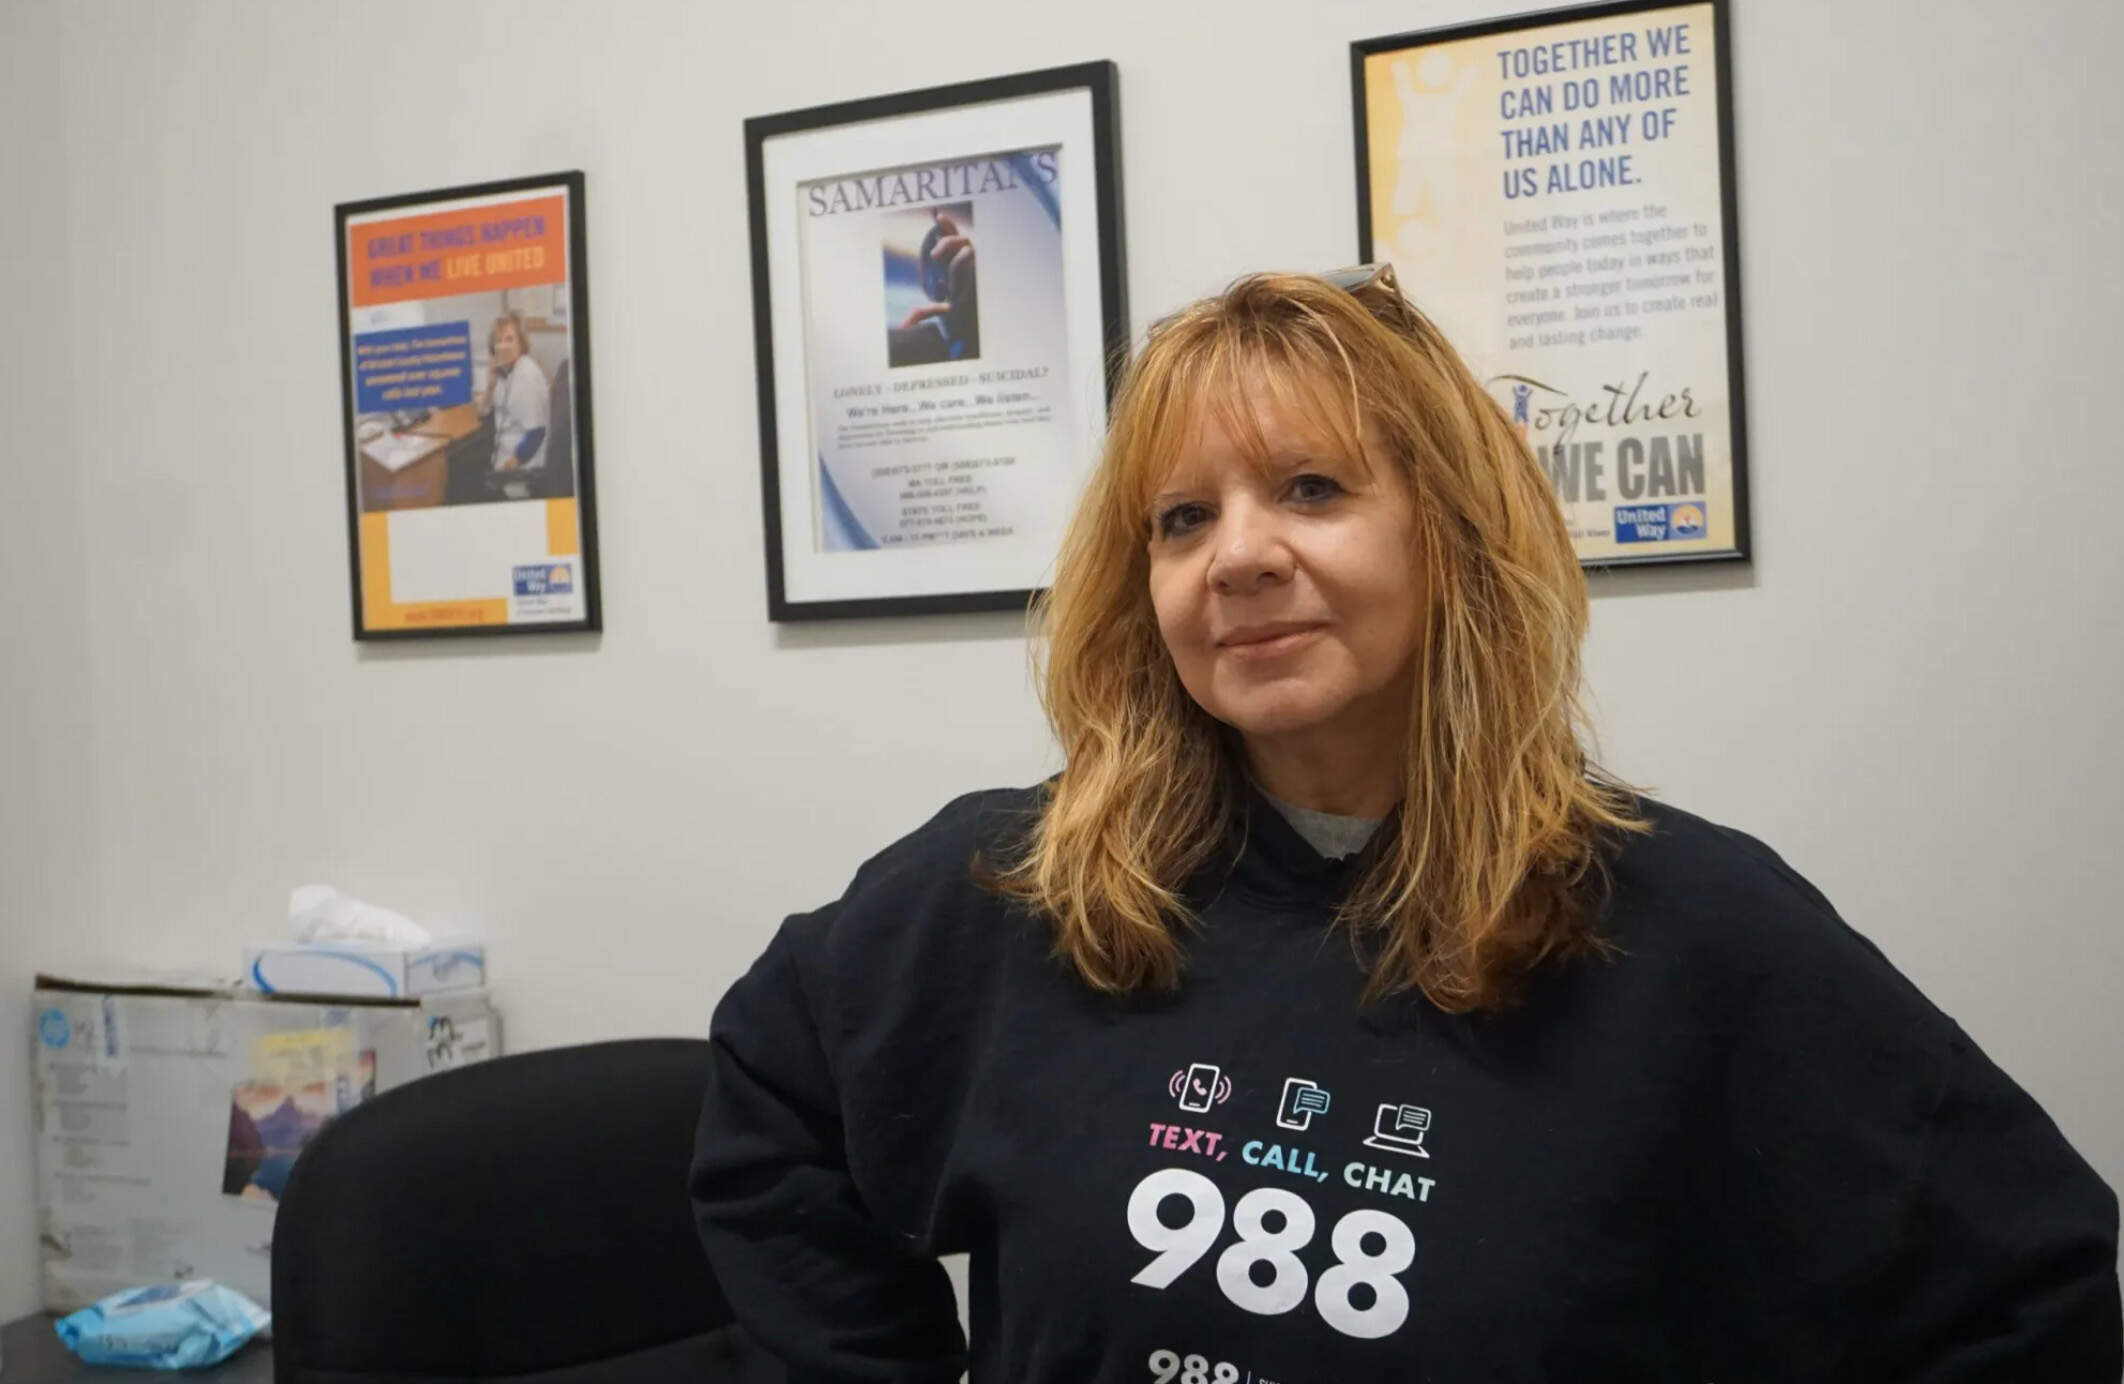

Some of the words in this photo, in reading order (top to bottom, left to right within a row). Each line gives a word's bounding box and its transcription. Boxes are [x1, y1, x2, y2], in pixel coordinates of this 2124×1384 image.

[1497, 32, 1638, 80] TOGETHER
[1646, 24, 1691, 58] WE
[1501, 85, 1553, 120] CAN
[1563, 78, 1599, 111] DO
[1610, 65, 1691, 105] MORE
[1500, 123, 1569, 159] THAN
[1579, 114, 1632, 150] ANY
[1642, 108, 1677, 141] OF
[1504, 168, 1538, 200] US
[1547, 155, 1642, 194] ALONE.
[419, 225, 475, 250] THINGS
[480, 215, 545, 243] HAPPEN
[1503, 216, 1547, 236] United
[1598, 208, 1639, 225] where
[1643, 204, 1667, 219] the
[1582, 232, 1626, 249] comes
[1631, 225, 1688, 246] together
[1693, 223, 1707, 237] to
[370, 264, 414, 288] WHEN
[419, 259, 441, 281] WE
[447, 253, 482, 280] LIVE
[486, 246, 545, 274] UNITED
[1504, 264, 1535, 282] help
[1538, 259, 1582, 279] people
[1586, 255, 1625, 275] today
[1646, 250, 1681, 267] ways
[1685, 245, 1716, 260] that
[1506, 286, 1548, 304] create
[1565, 280, 1621, 298] stronger
[1625, 300, 1638, 315] to
[1642, 296, 1686, 313] create
[1690, 292, 1718, 309] real
[1509, 333, 1535, 351] and
[1538, 327, 1586, 347] lasting
[1485, 370, 1702, 457] Together
[1537, 441, 1607, 503] WE
[1616, 433, 1706, 502] CAN
[1615, 507, 1667, 526] United
[1637, 522, 1667, 541] Way
[1149, 1122, 1229, 1163] TEXT,
[1241, 1140, 1330, 1183] CALL,
[1343, 1162, 1437, 1203] CHAT
[1127, 1168, 1416, 1340] 988
[1148, 1349, 1240, 1384] 988
